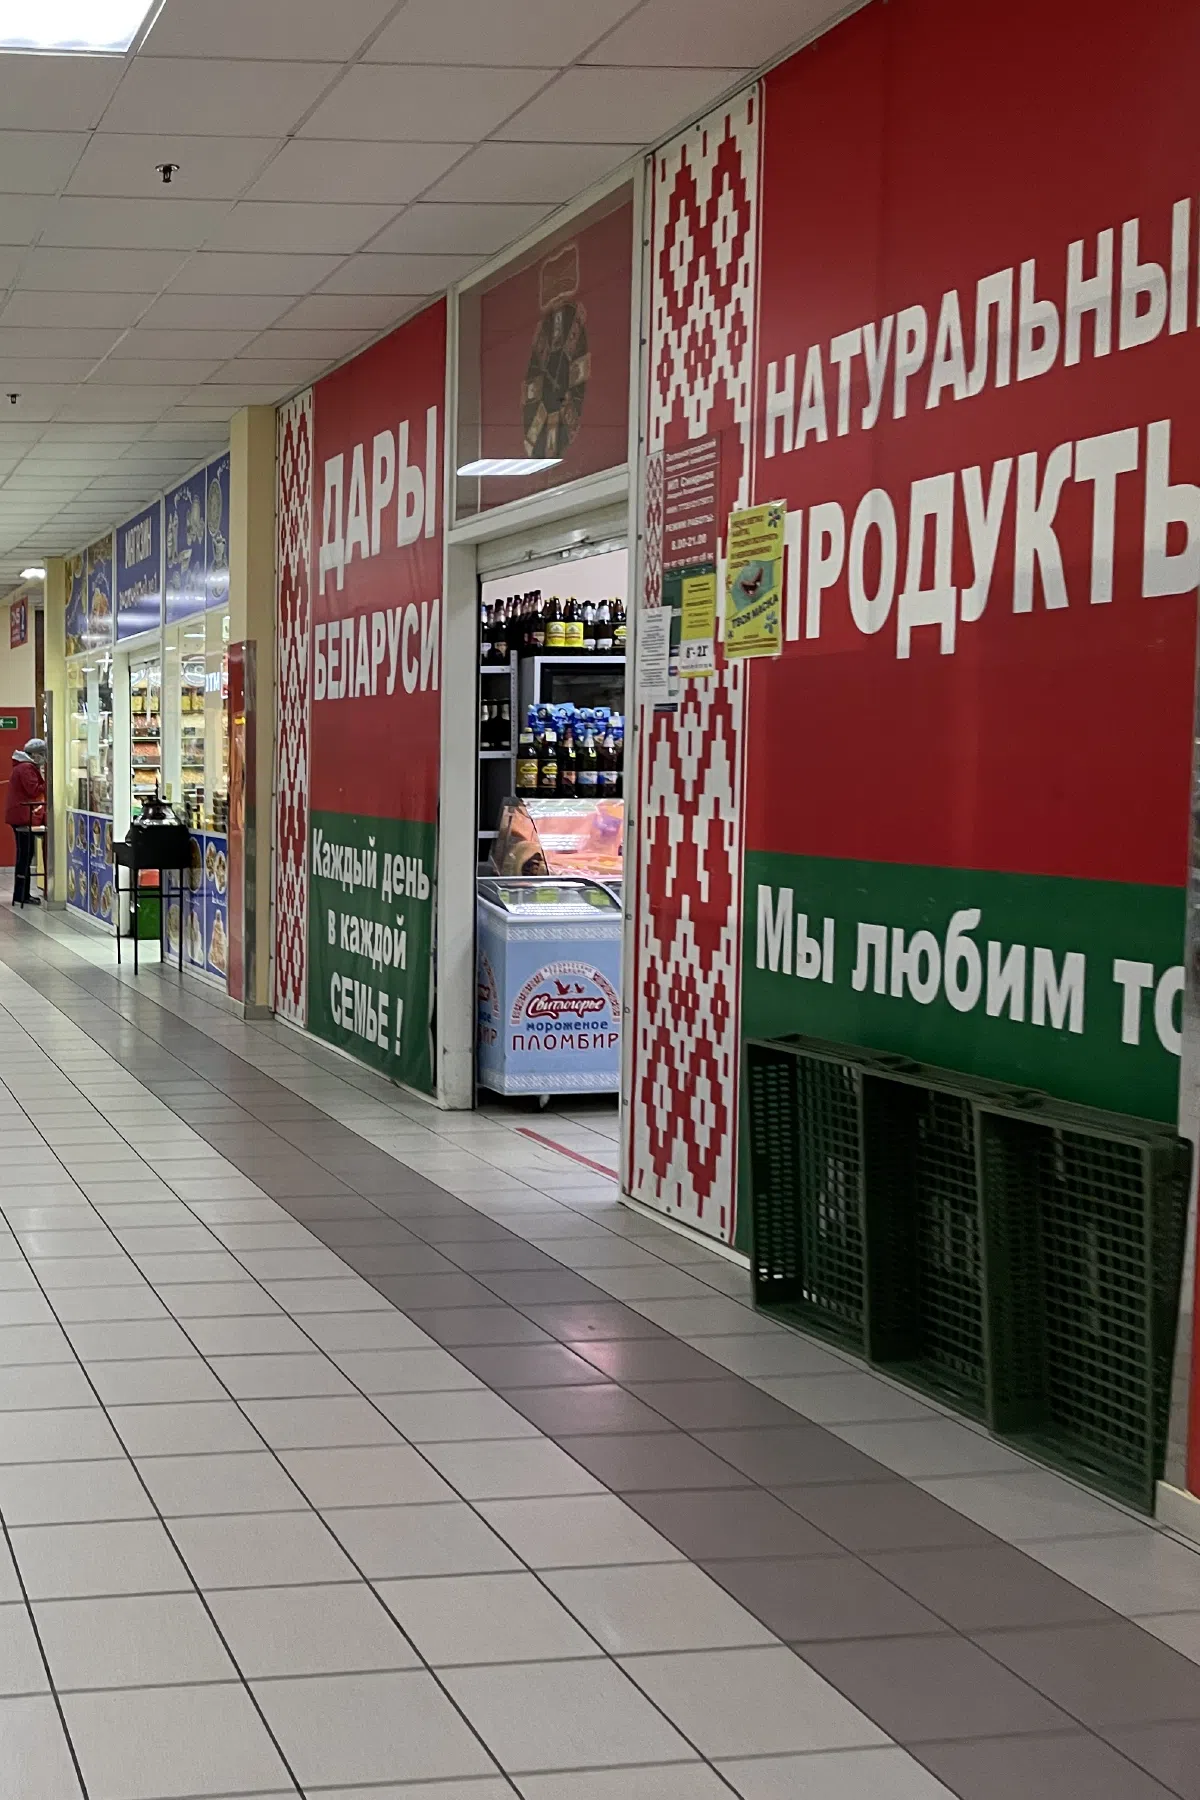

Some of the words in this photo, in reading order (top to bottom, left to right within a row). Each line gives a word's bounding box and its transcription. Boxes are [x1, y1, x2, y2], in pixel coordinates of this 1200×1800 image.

[764, 197, 1200, 459] НАТУРАЛЬНЫ
[319, 405, 438, 596] ДАРЫ
[314, 598, 440, 701] БЕЛАРУСИ
[312, 828, 378, 894] Каждый
[382, 852, 430, 904] день
[327, 909, 336, 945] в
[340, 912, 407, 974] каждой
[756, 884, 835, 984] Мы
[852, 908, 1086, 1034] любим
[330, 971, 390, 1051] СЕМЬЕ
[512, 1033, 620, 1051] ПЛОМБИР
[526, 1020, 608, 1033] мороженое
